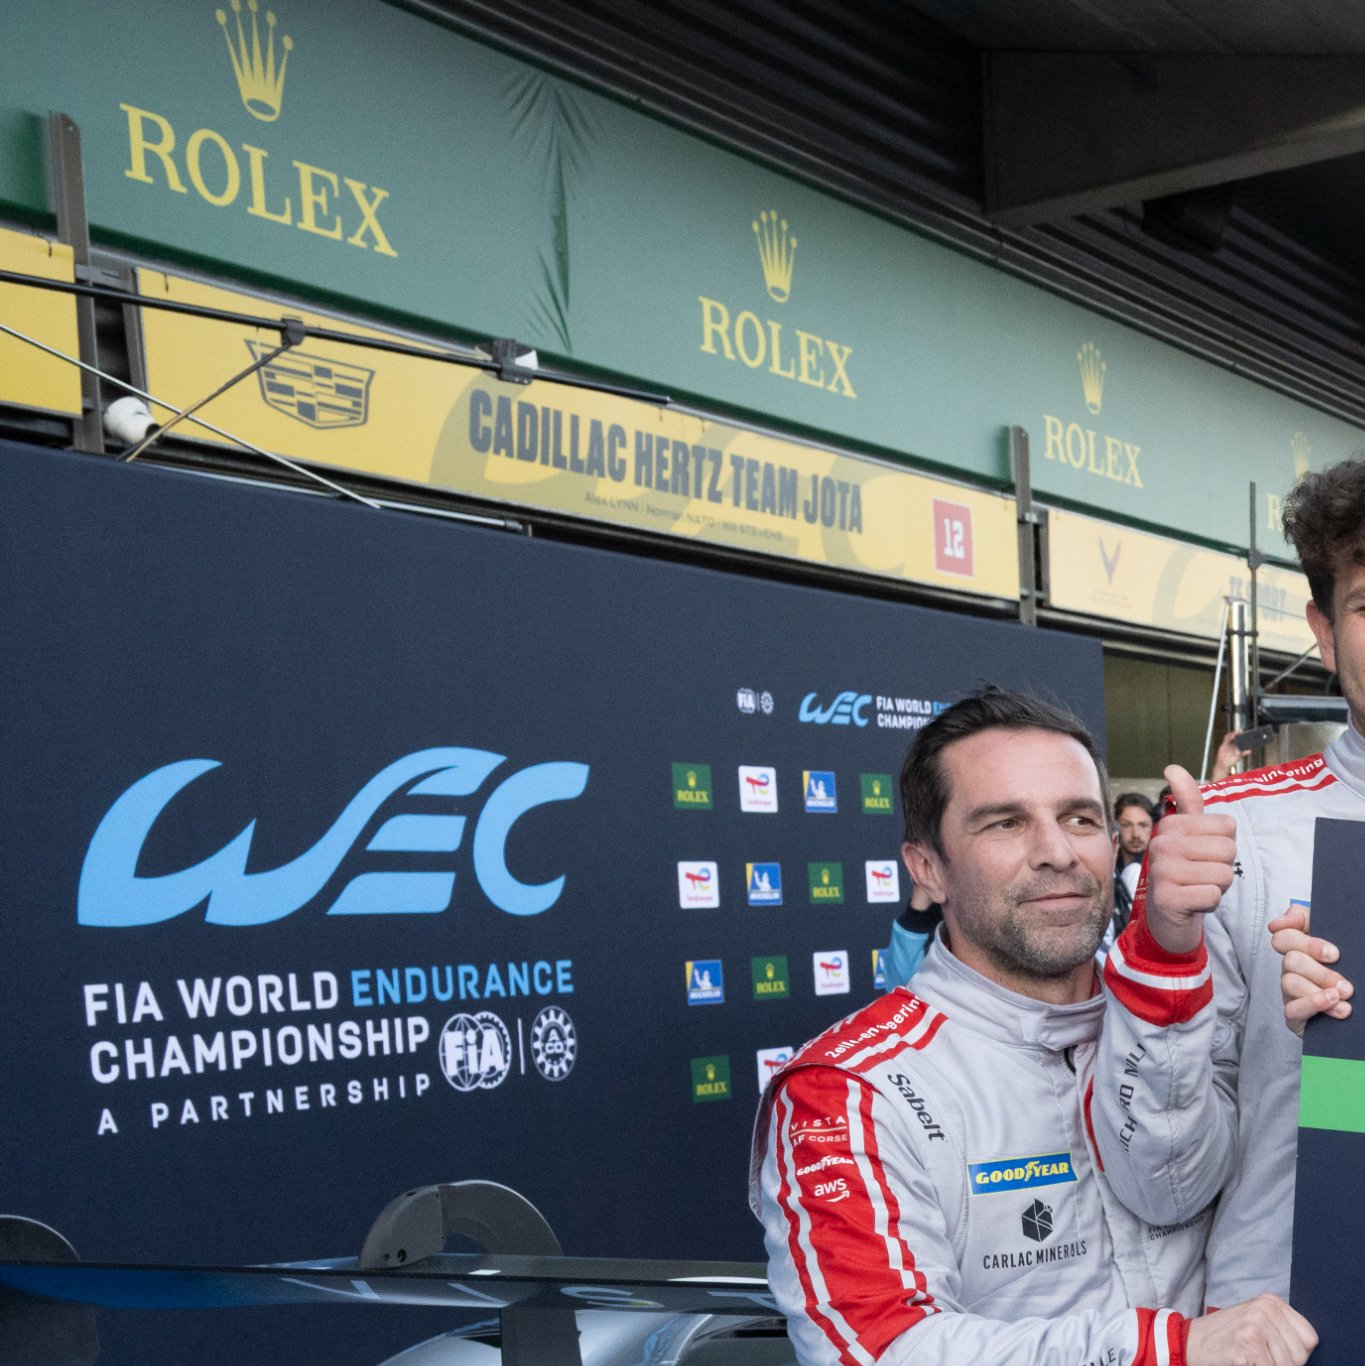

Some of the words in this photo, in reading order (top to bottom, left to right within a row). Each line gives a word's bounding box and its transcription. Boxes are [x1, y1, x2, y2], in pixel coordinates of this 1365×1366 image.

[119, 103, 398, 258] ROLEX
[699, 296, 857, 399] ROLEX
[469, 389, 627, 483] CADILLAC
[634, 430, 723, 504] HERTZ
[730, 454, 797, 520] TEAM
[803, 474, 862, 534] JOTA
[1044, 414, 1143, 488] ROLEX
[609, 497, 639, 512] LYNN
[686, 512, 715, 528] NATO
[944, 518, 964, 559] 12
[799, 691, 872, 727] WEC
[876, 696, 894, 710] FIA
[896, 698, 932, 714] WORLD
[677, 790, 708, 803] ROLEX
[864, 798, 890, 808] ROLEX
[78, 746, 589, 927] WEC
[812, 887, 840, 898] ROLEX
[84, 982, 163, 1026] FIA
[178, 971, 338, 1019] WORLD
[351, 960, 574, 1007] ENDURANCE
[689, 989, 721, 1000] MICHELIN
[756, 981, 785, 993] ROLEX
[90, 1016, 430, 1083] CHAMPIONSHIP
[695, 1082, 727, 1096] ROLEX
[98, 1109, 118, 1135] A
[151, 1074, 431, 1128] PARTNERSHIP
[888, 1074, 946, 1142] Sabelt
[791, 1116, 846, 1131] VISTA
[793, 1135, 805, 1148] AF
[809, 1134, 848, 1142] CORSE
[797, 1155, 854, 1176] GOODYEAR
[975, 1161, 1069, 1184] GOODYEAR
[814, 1179, 847, 1196] aws
[983, 1251, 1033, 1269] CARLAC
[1036, 1241, 1087, 1265] MINERALS
